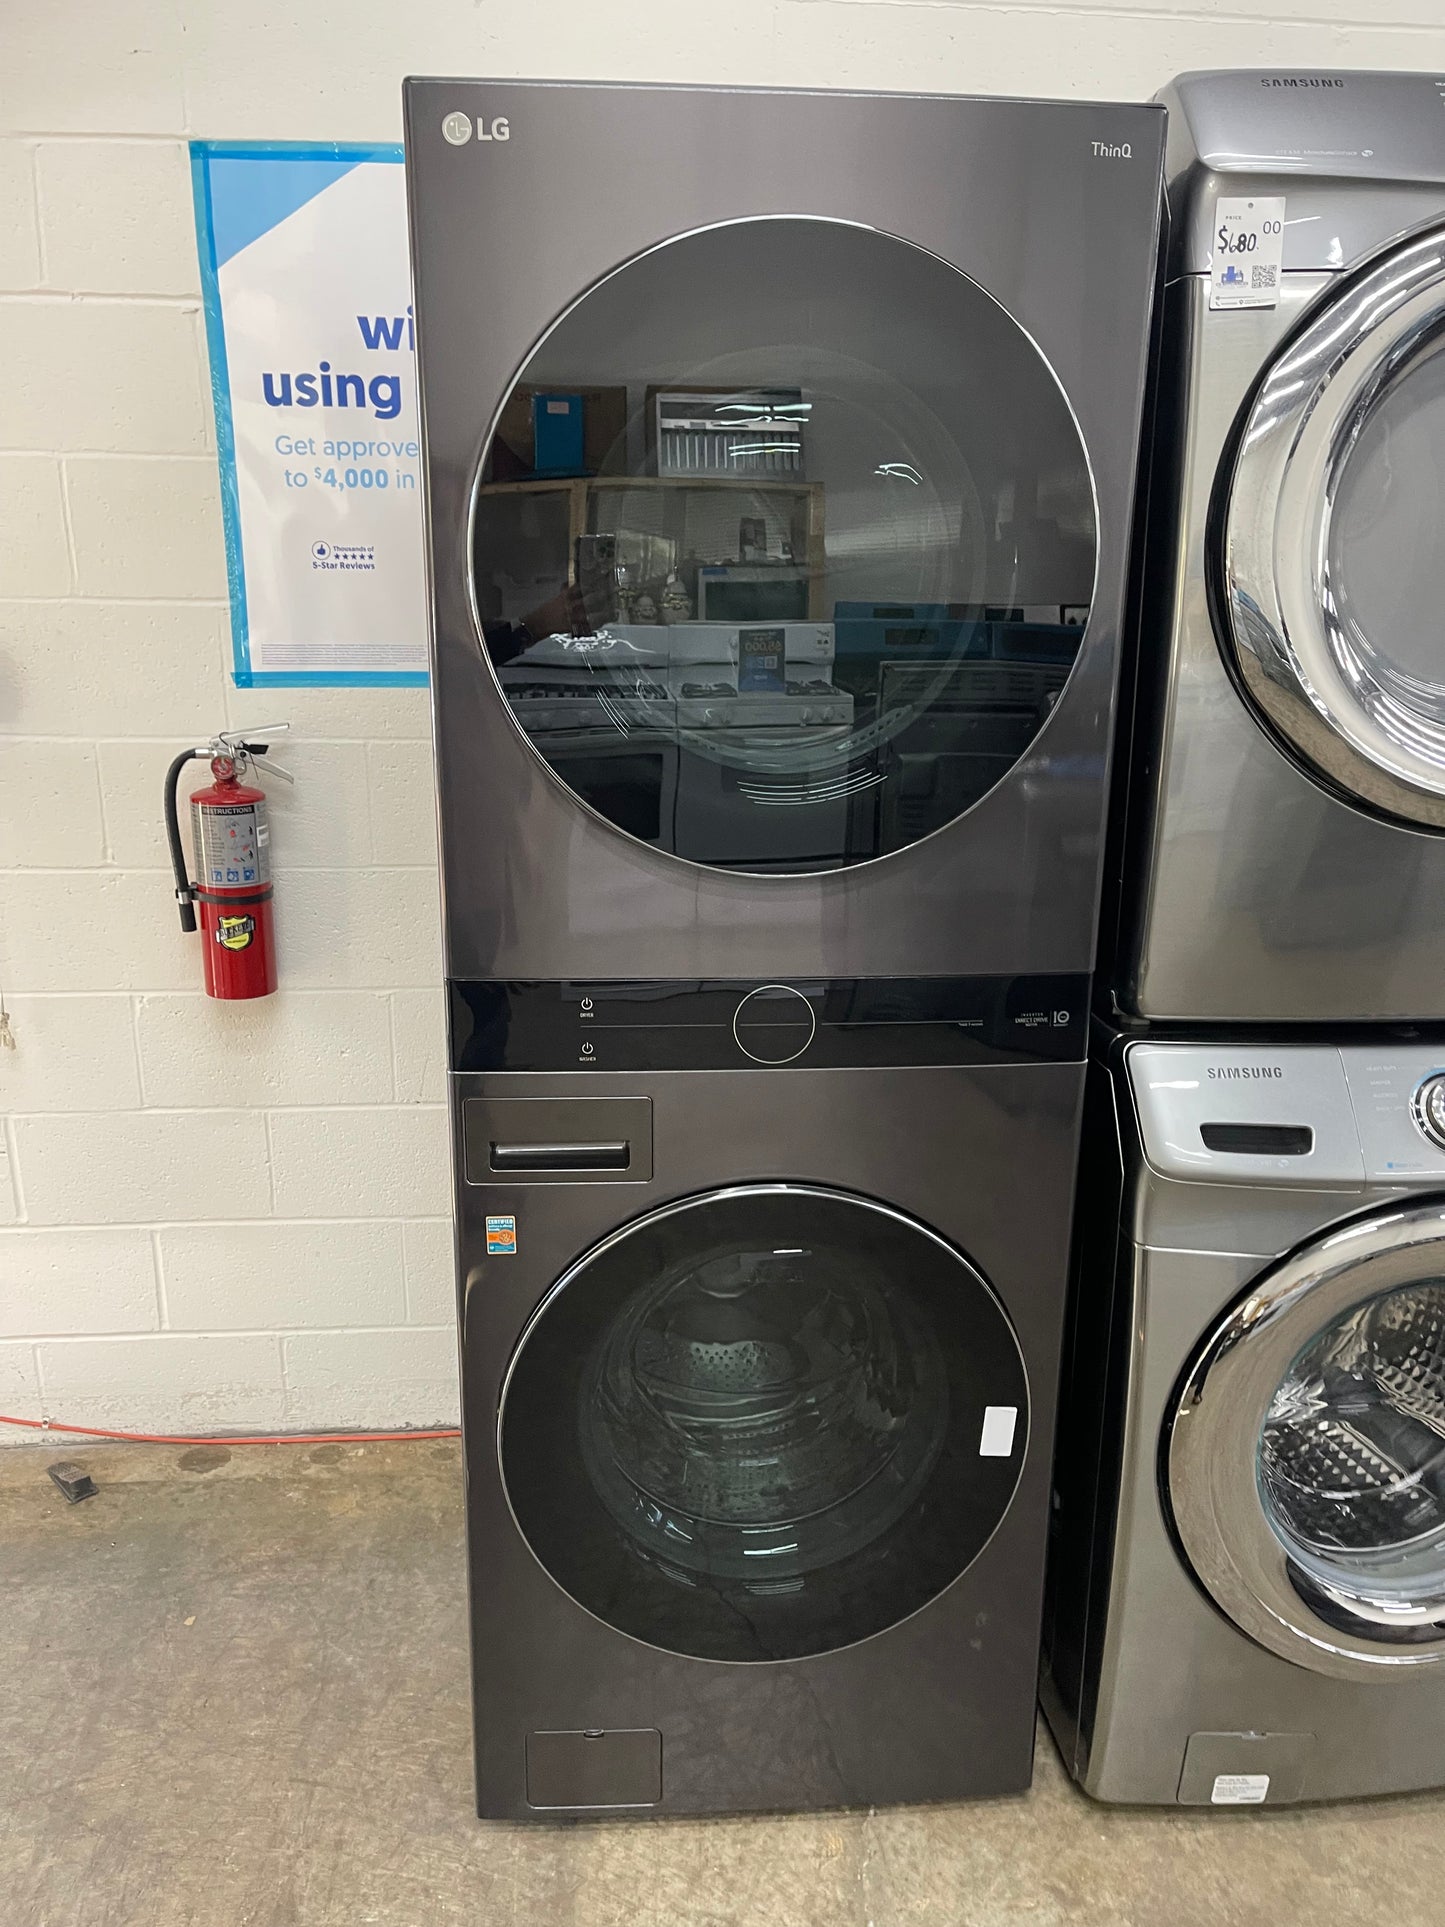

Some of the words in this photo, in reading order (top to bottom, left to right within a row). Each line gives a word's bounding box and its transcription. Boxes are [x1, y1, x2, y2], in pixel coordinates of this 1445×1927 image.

[1261, 78, 1344, 88] SAMSUNG
[476, 116, 510, 141] LG
[1091, 141, 1132, 159] ThinQ
[1263, 220, 1281, 235] 00
[262, 361, 402, 419] using
[275, 435, 316, 455] Get
[323, 440, 418, 461] approve
[284, 470, 308, 488] to
[314, 466, 389, 491] $4,000
[396, 469, 415, 489] in
[312, 561, 338, 569] 5-Star
[340, 562, 375, 570] Reviews
[1207, 1066, 1283, 1079] SAMSUNG
